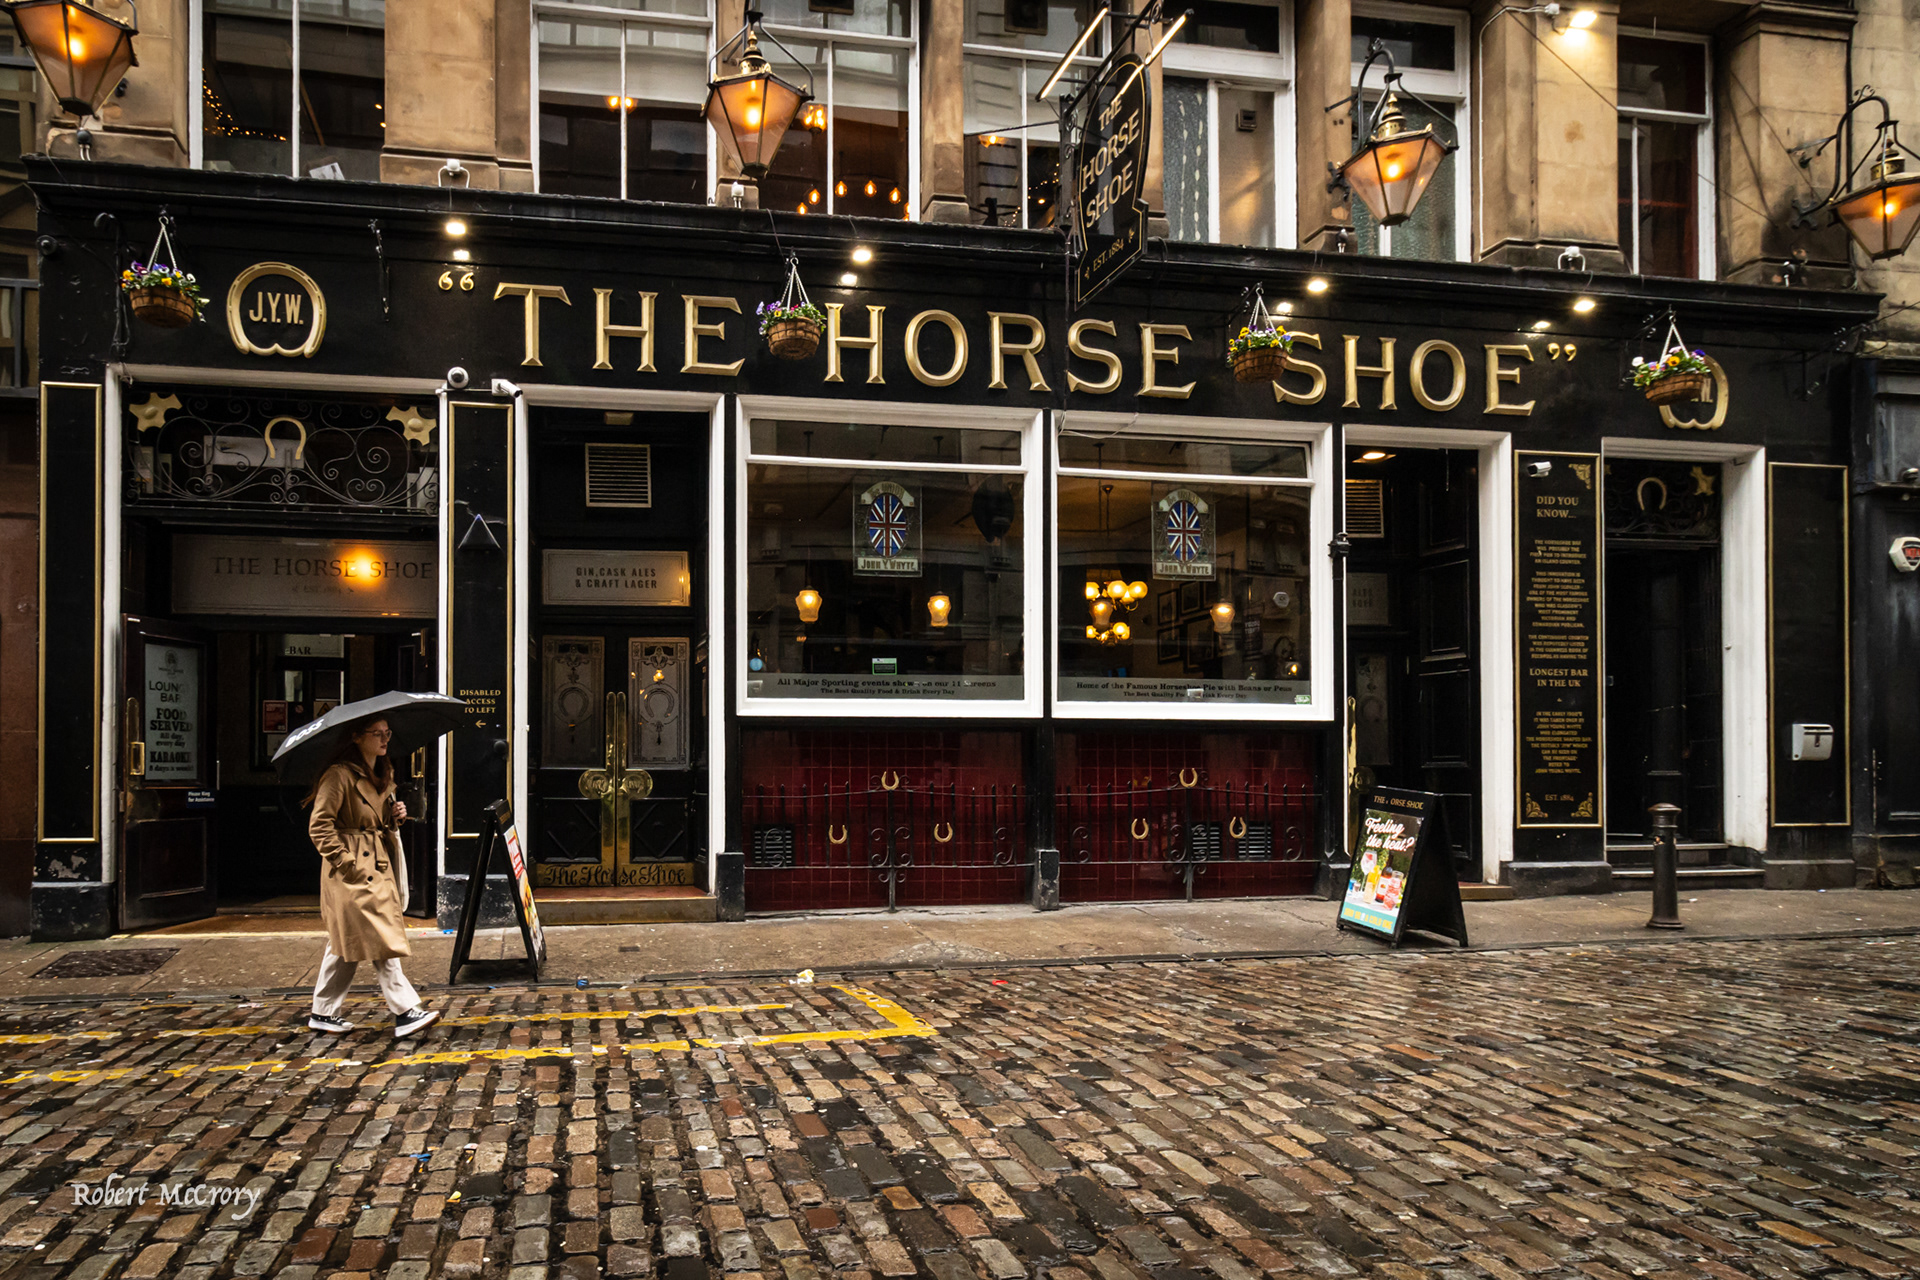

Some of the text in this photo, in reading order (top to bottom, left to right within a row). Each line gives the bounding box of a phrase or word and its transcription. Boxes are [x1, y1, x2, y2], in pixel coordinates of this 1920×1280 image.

[1098, 96, 1122, 131] THE
[1081, 108, 1140, 193] HORSE
[1086, 160, 1133, 228] SHOE
[824, 302, 1197, 399] HORSE
[1536, 496, 1579, 506] DID YOU
[211, 556, 432, 579] THE HORSE SHOE
[632, 568, 656, 578] ALES
[576, 579, 658, 589] & CRAFT LAGER
[288, 646, 311, 656] BAR
[1530, 668, 1569, 676] LONGEST
[794, 678, 819, 688] Major
[822, 679, 859, 688] Sporting
[156, 708, 188, 720] FOOD
[150, 720, 193, 732] SERVED
[285, 718, 325, 748] BOSS
[1374, 796, 1386, 804] THE
[1365, 817, 1405, 840] Feeling
[1366, 834, 1415, 852] the heat?
[544, 864, 578, 885] The
[638, 863, 686, 885] Shoe
